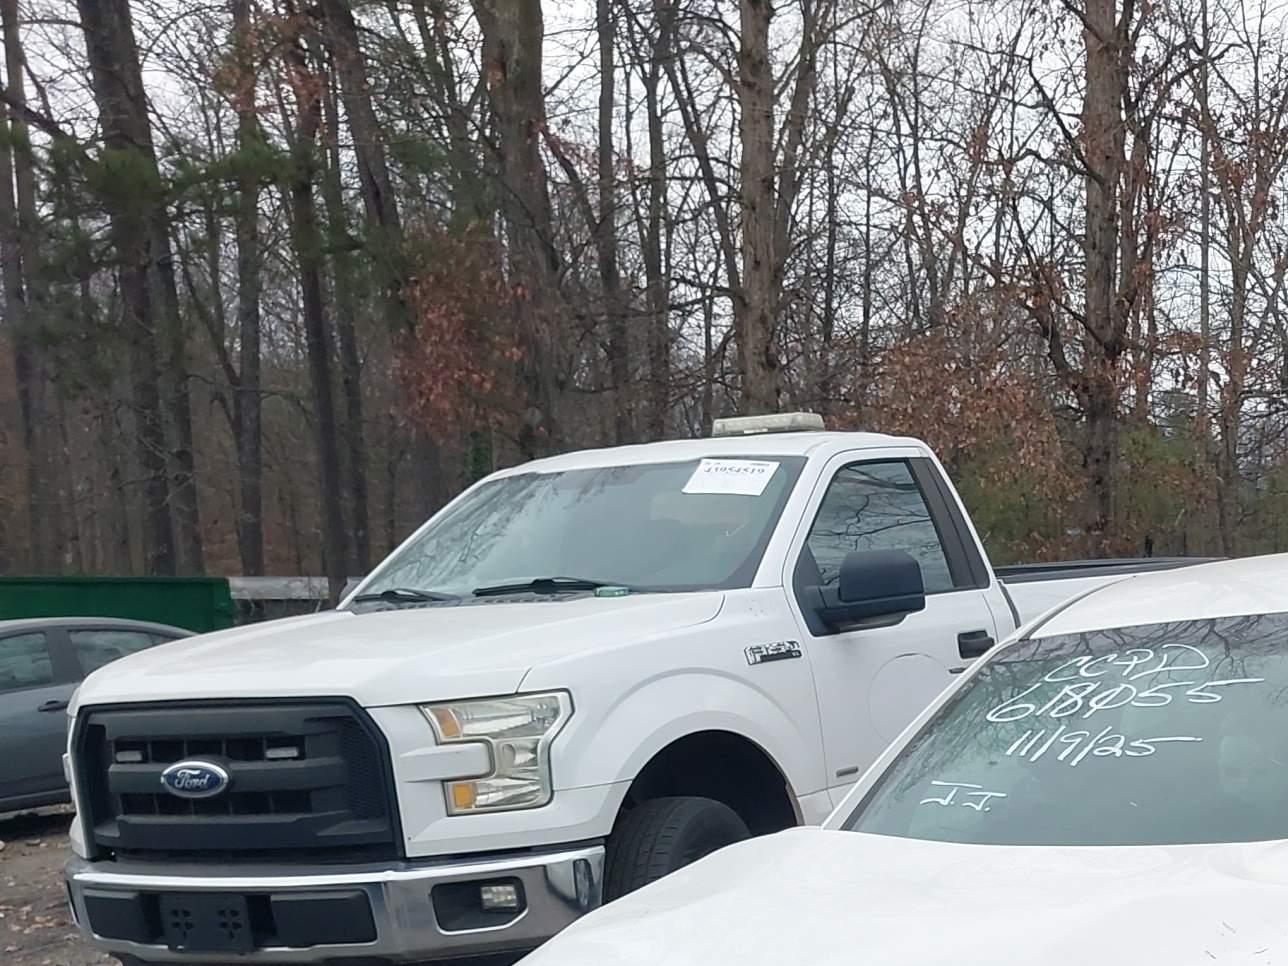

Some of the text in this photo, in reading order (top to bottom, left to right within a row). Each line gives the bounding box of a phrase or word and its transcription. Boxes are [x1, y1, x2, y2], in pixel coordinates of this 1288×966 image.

[1045, 643, 1209, 681] CCPD
[1006, 726, 1203, 766] 11/9/25
[174, 769, 210, 788] Ford
